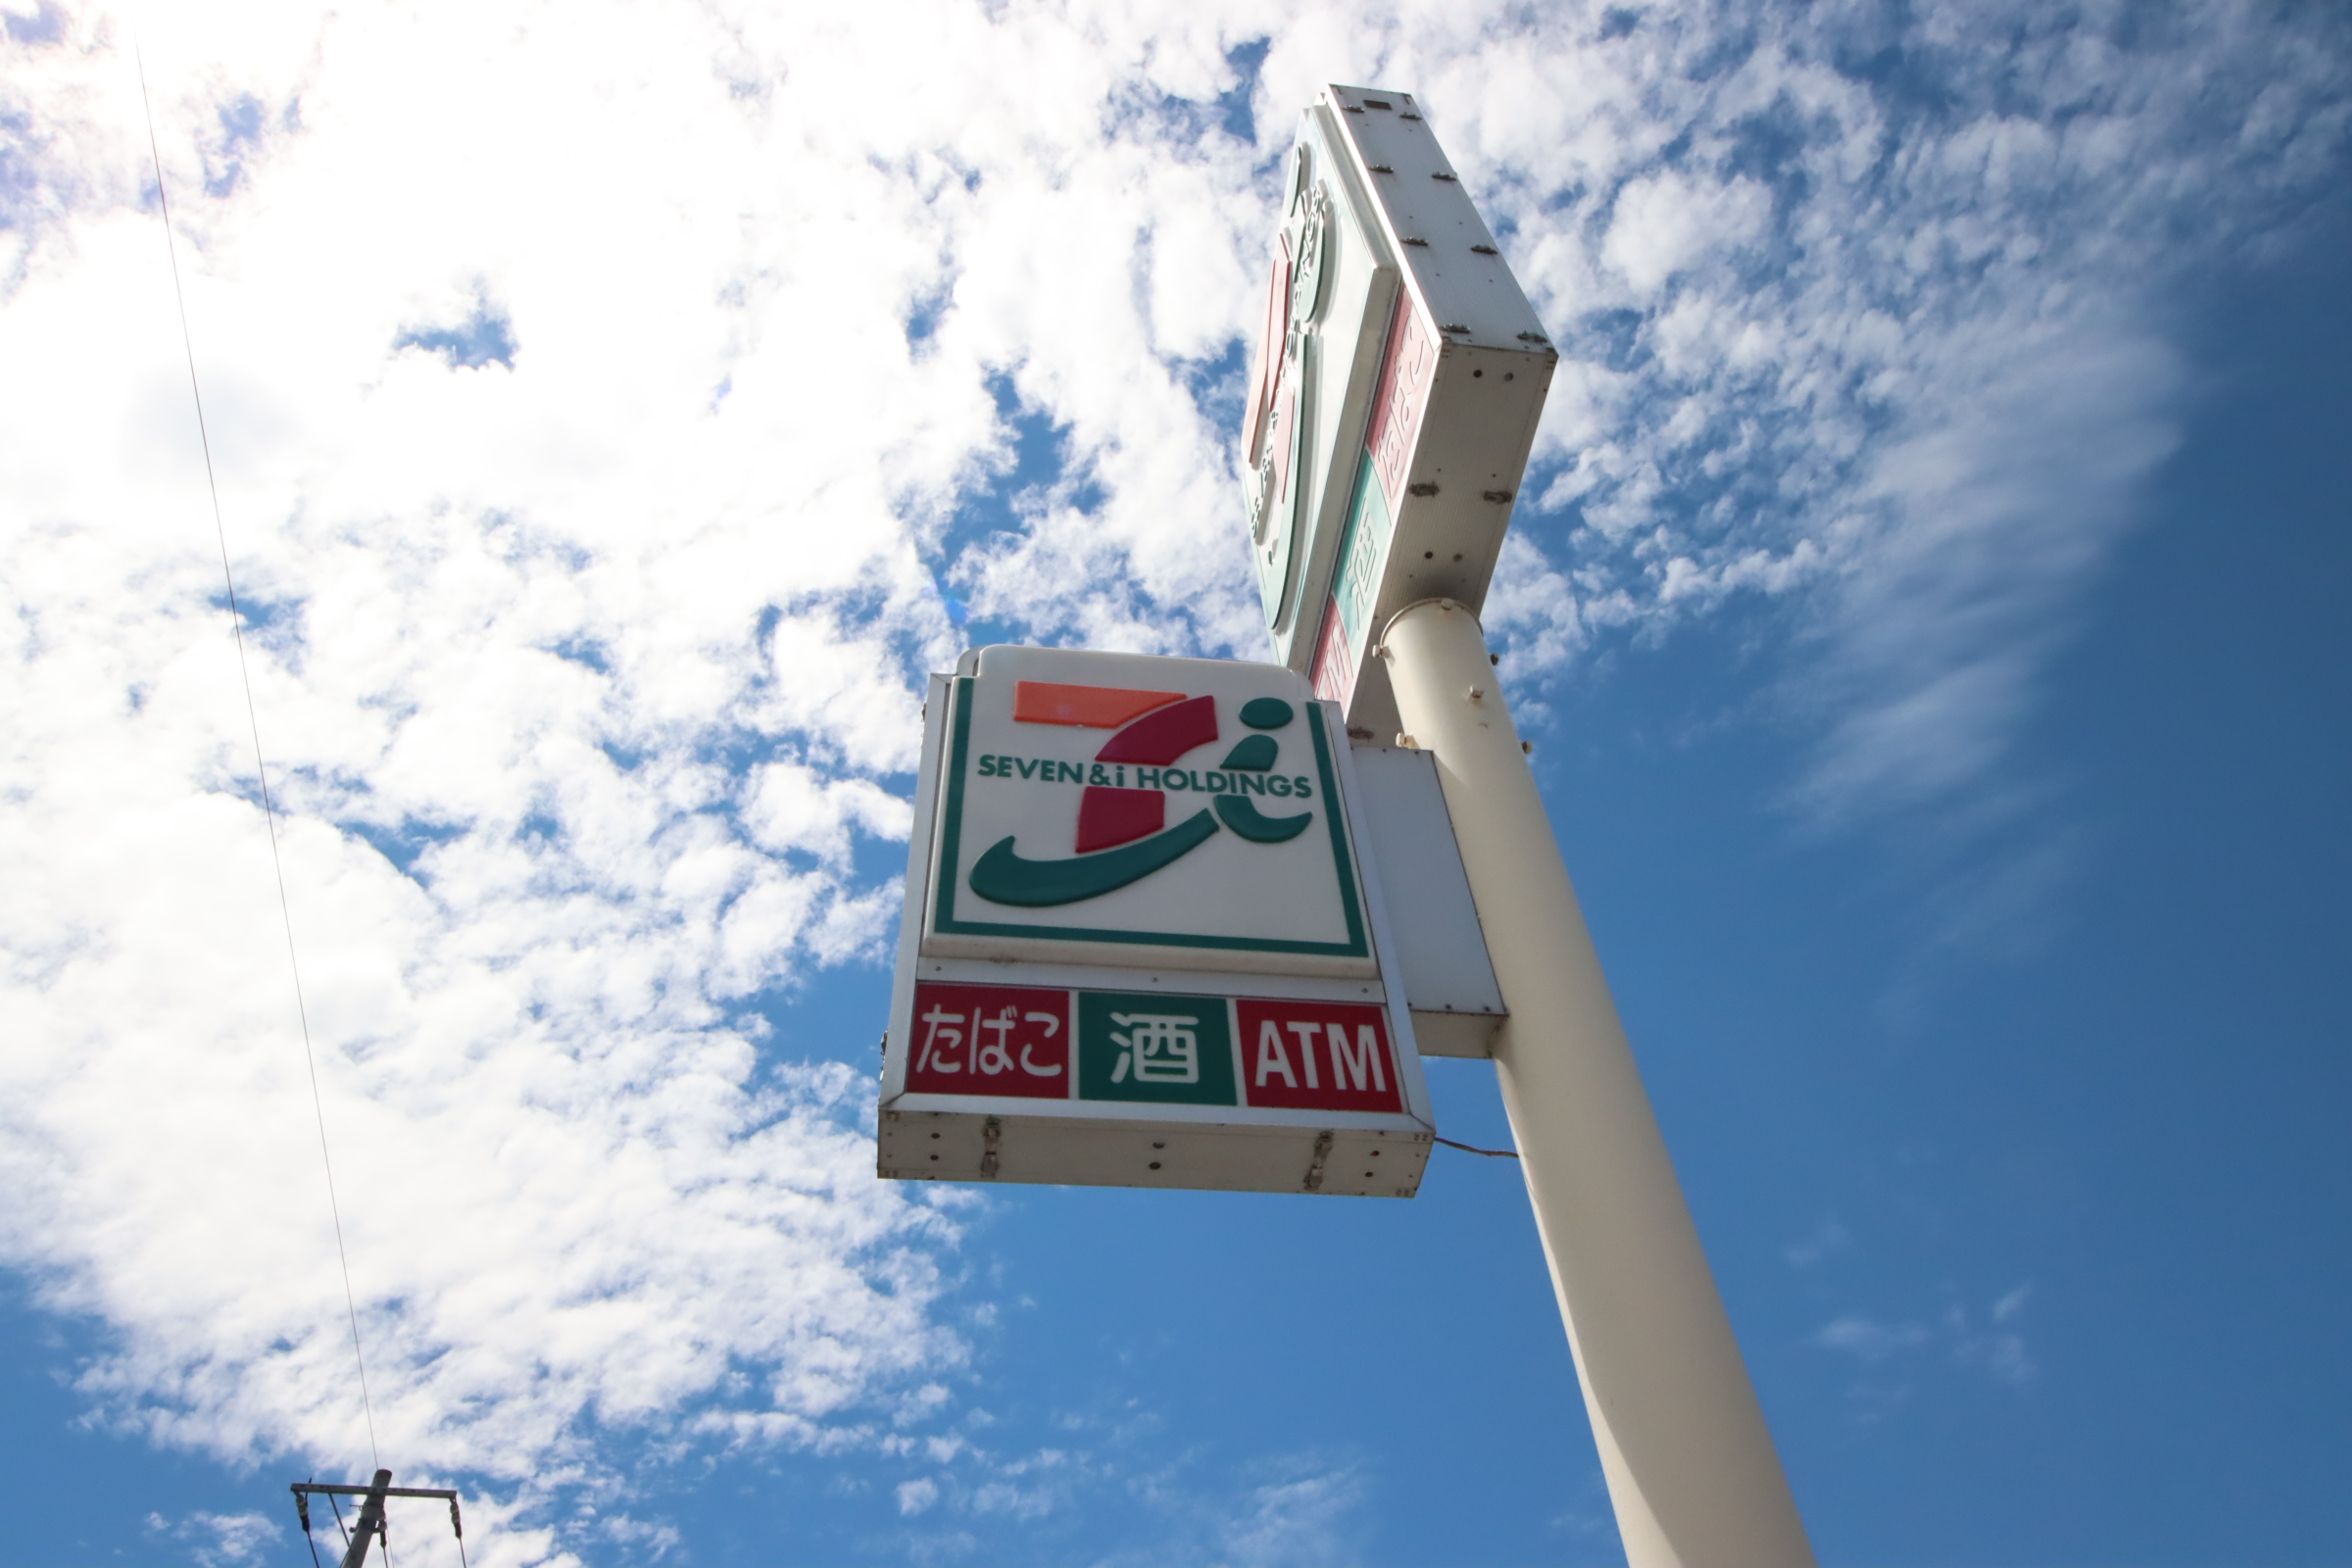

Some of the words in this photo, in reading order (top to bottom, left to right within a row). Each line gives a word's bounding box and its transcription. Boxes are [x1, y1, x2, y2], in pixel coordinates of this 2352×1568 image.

[1137, 765, 1313, 799] HOLDINGS
[915, 1003, 1062, 1077] たばこ
[1109, 1010, 1200, 1085] 酒
[1254, 1019, 1388, 1093] ATM
